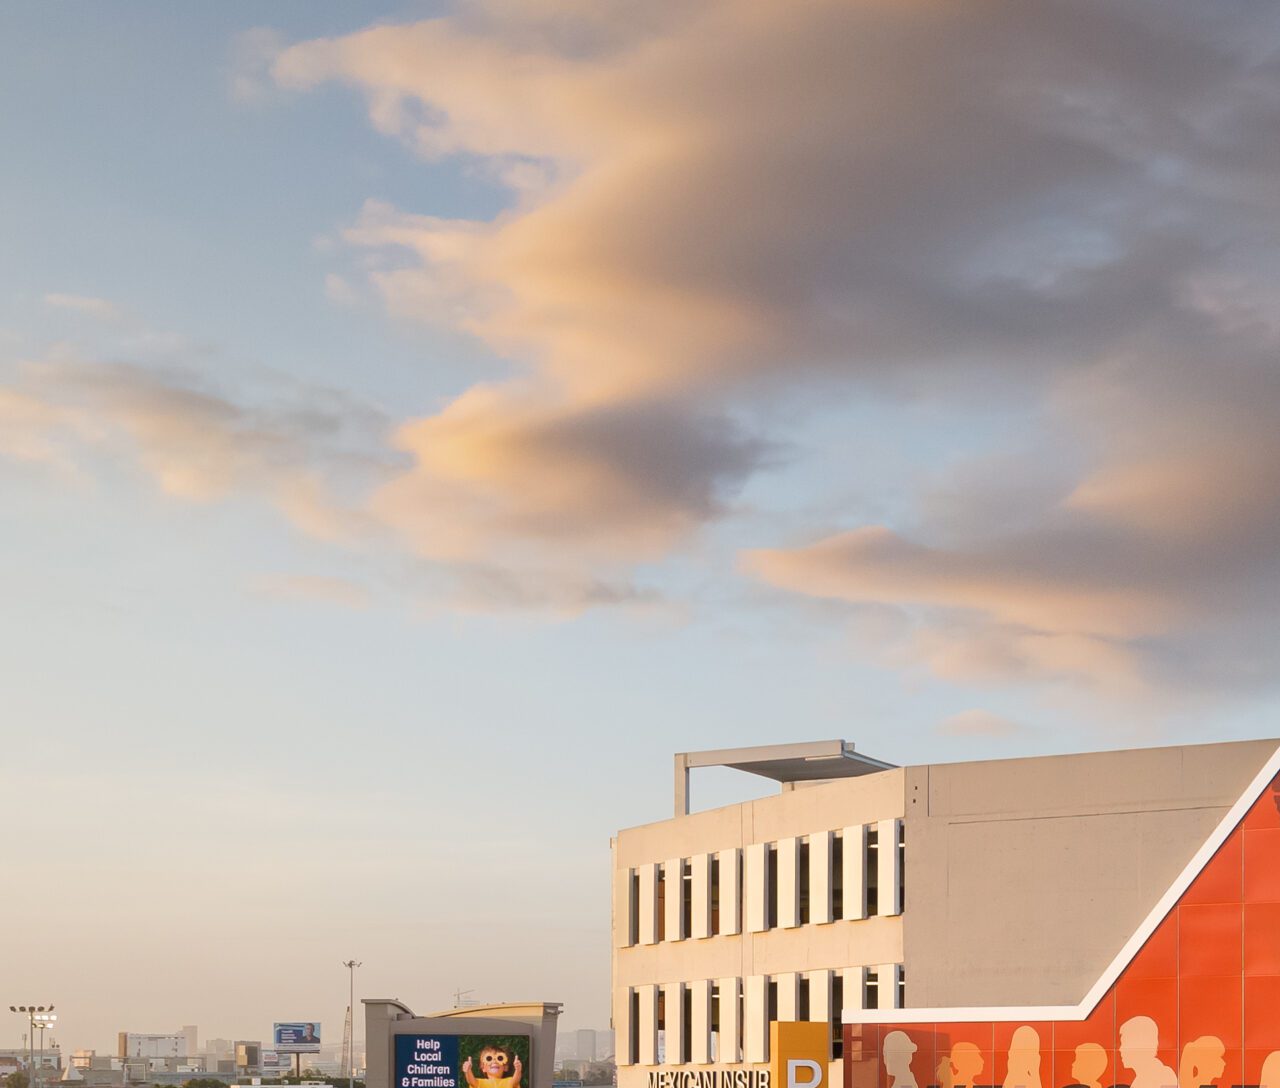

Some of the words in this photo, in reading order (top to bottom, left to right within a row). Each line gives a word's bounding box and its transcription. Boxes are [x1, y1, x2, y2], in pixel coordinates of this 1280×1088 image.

[416, 1039, 441, 1050] Help
[414, 1051, 442, 1061] Local
[407, 1063, 450, 1074] Children
[402, 1077, 410, 1087] &
[411, 1077, 455, 1087] Families
